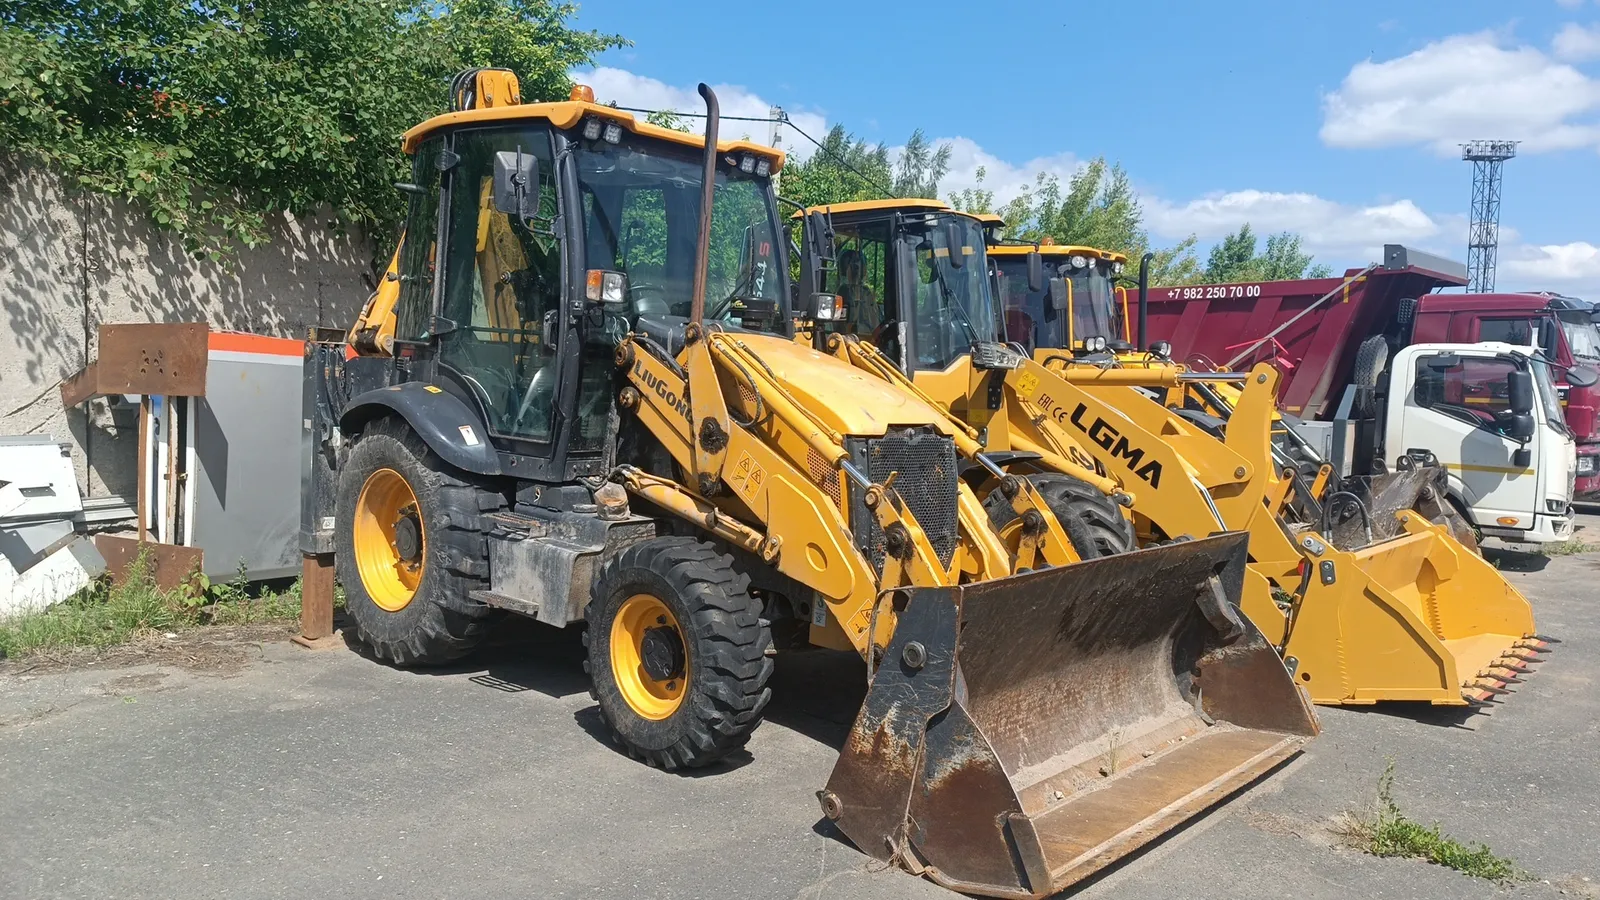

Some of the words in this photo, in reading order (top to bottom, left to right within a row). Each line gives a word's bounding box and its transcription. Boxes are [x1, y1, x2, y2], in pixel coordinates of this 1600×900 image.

[1168, 288, 1180, 300] +7
[1183, 287, 1203, 299] 982
[1206, 286, 1226, 298] 250
[1230, 286, 1243, 297] 70
[1246, 285, 1260, 297] 00
[1037, 393, 1054, 411] EAC
[1052, 407, 1068, 423] CE
[1070, 402, 1163, 490] LGMA
